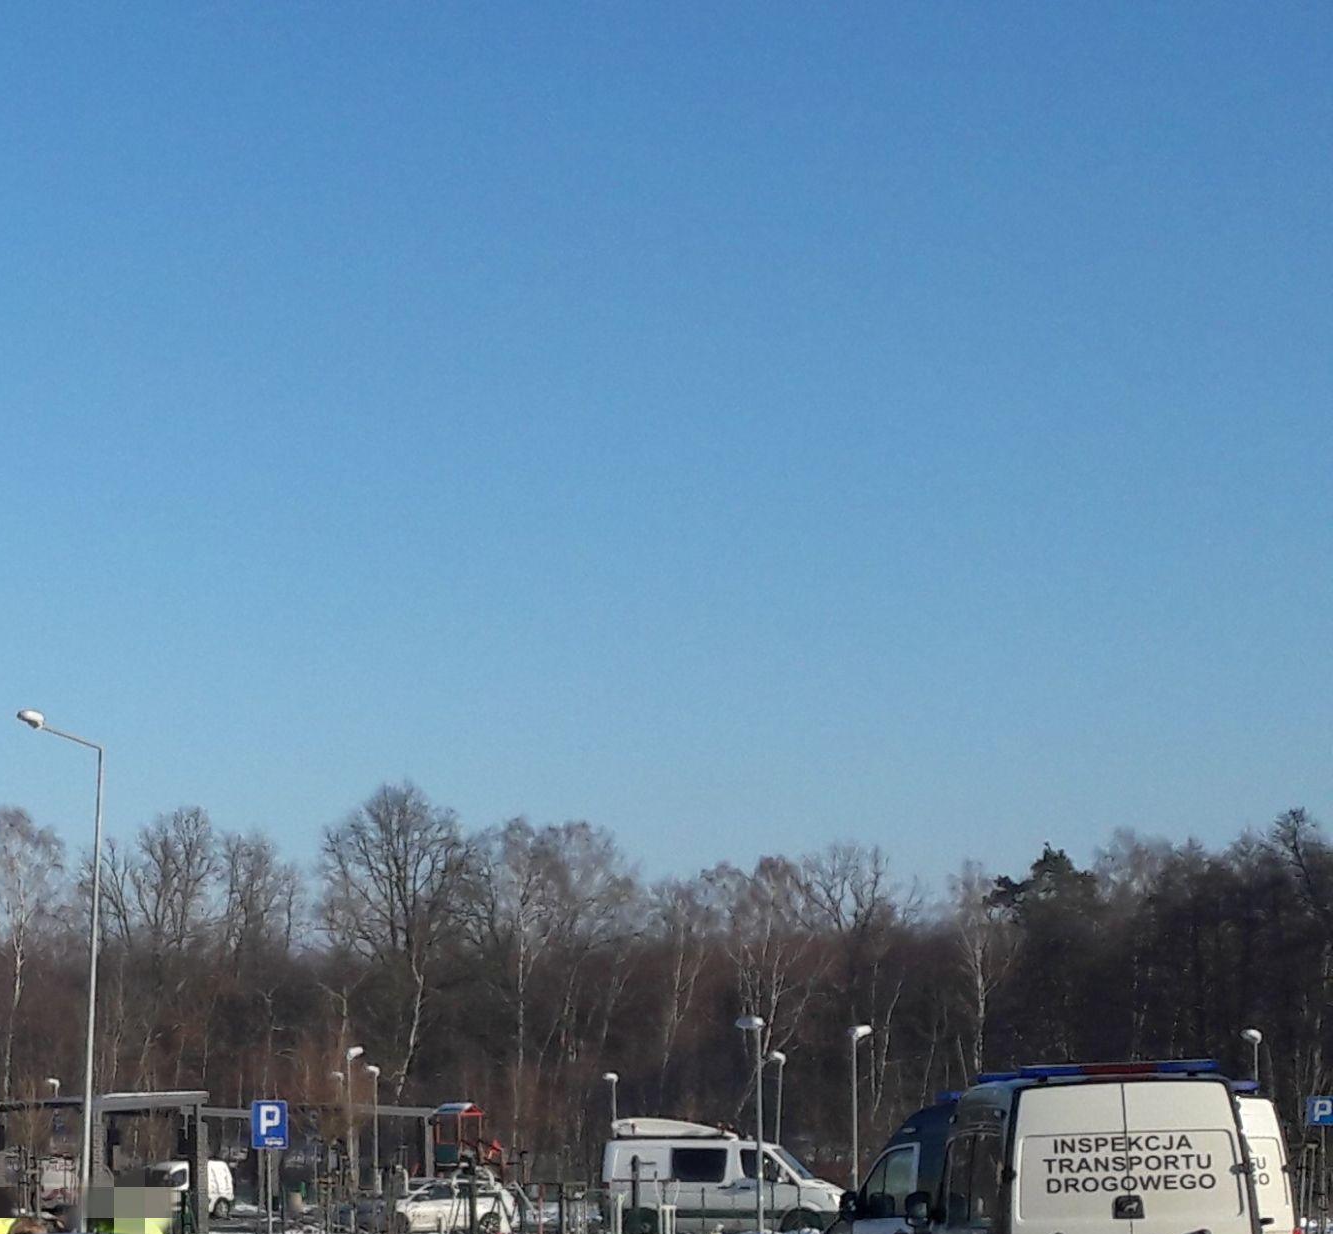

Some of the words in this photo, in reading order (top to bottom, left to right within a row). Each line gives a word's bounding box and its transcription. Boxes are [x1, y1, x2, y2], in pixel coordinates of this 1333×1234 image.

[260, 1105, 280, 1135] P
[1314, 1100, 1332, 1121] P
[1053, 1135, 1193, 1154] INSPEKCJA
[1043, 1154, 1212, 1174] TRANSPORTU
[1046, 1174, 1216, 1194] DROGOWEGO
